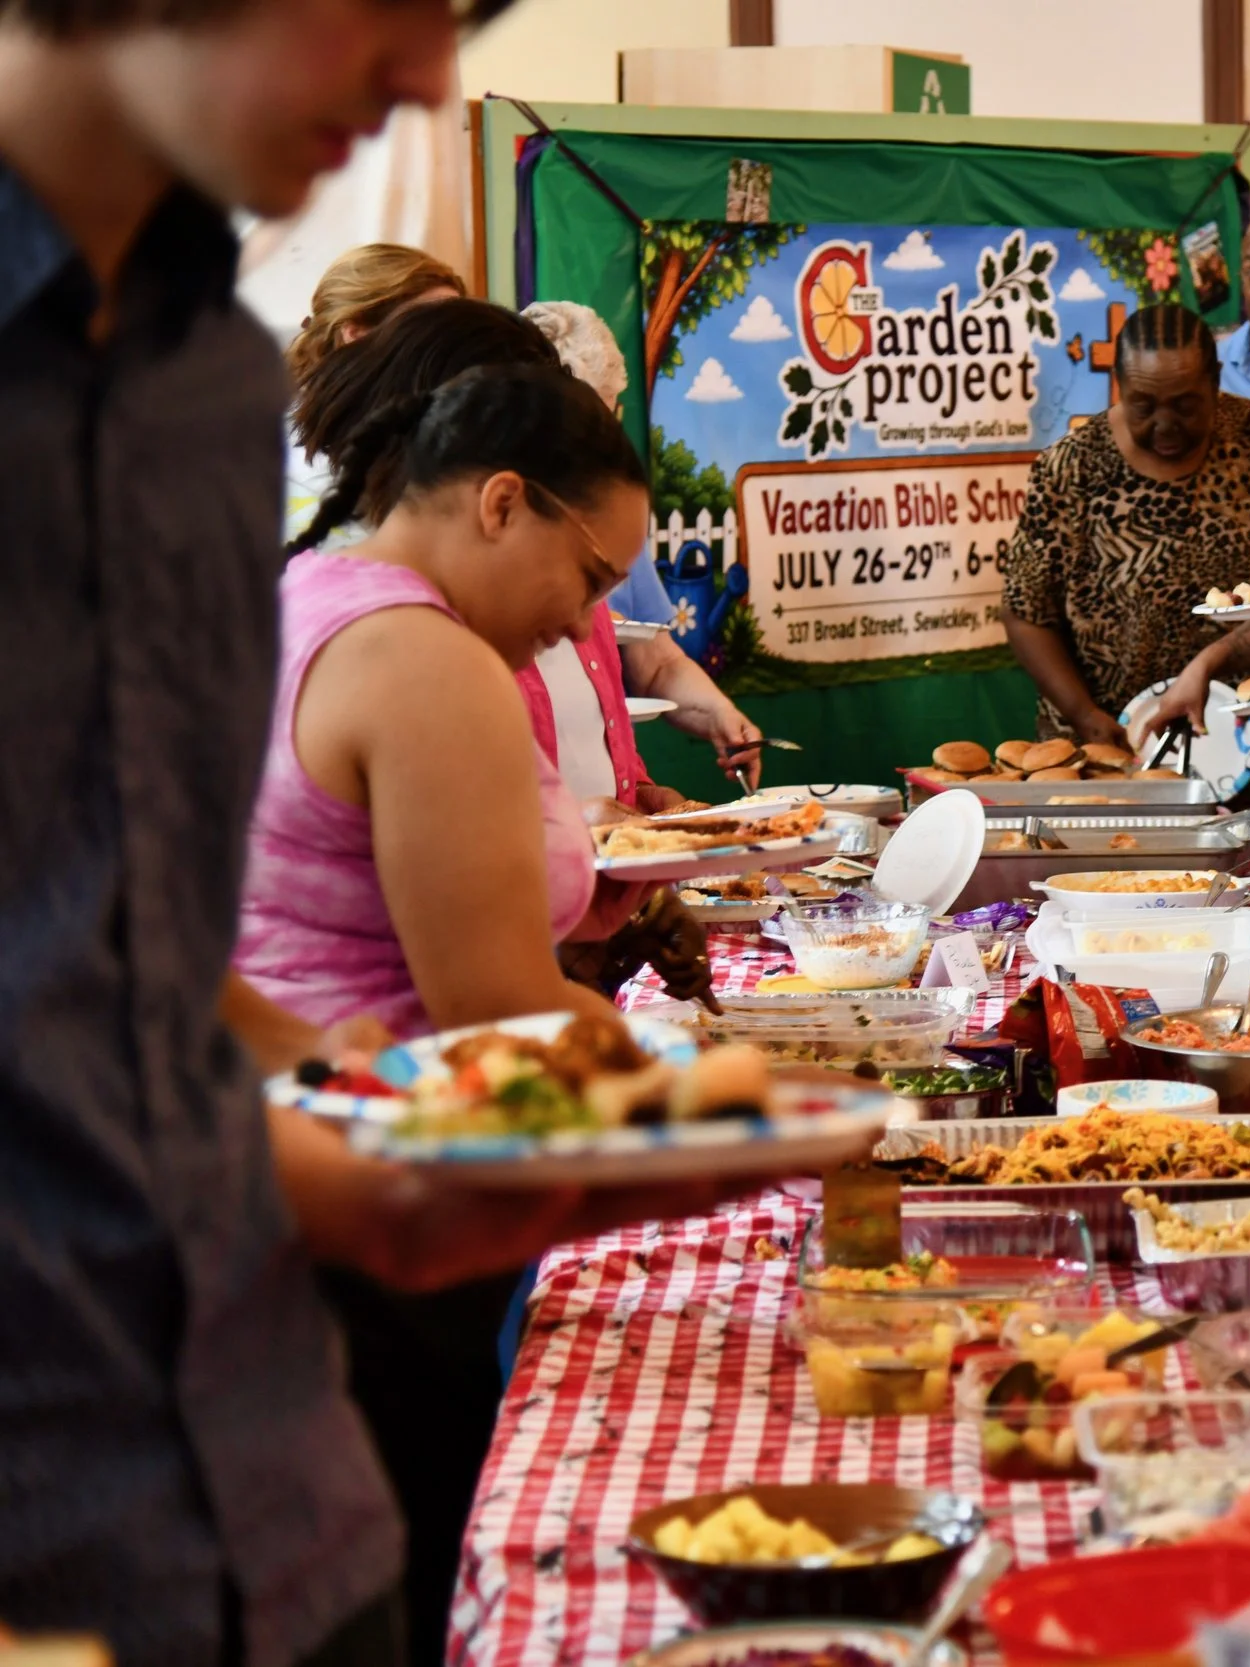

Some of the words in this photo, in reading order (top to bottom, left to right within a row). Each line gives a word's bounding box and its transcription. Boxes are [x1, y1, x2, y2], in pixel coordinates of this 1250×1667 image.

[800, 246, 1014, 375] Garden
[851, 293, 879, 311] THE
[863, 352, 1036, 422] project
[879, 422, 926, 444] Growing
[929, 420, 973, 442] through
[974, 421, 1004, 438] God's
[1006, 421, 1029, 436] love
[761, 486, 888, 536] Vacation
[893, 481, 958, 529] Bible
[966, 478, 1026, 524] Scho
[772, 549, 842, 591] JULY
[786, 621, 811, 645] 337
[813, 615, 856, 641] Broad
[859, 613, 909, 637] Street,
[913, 608, 983, 633] Sewickley,
